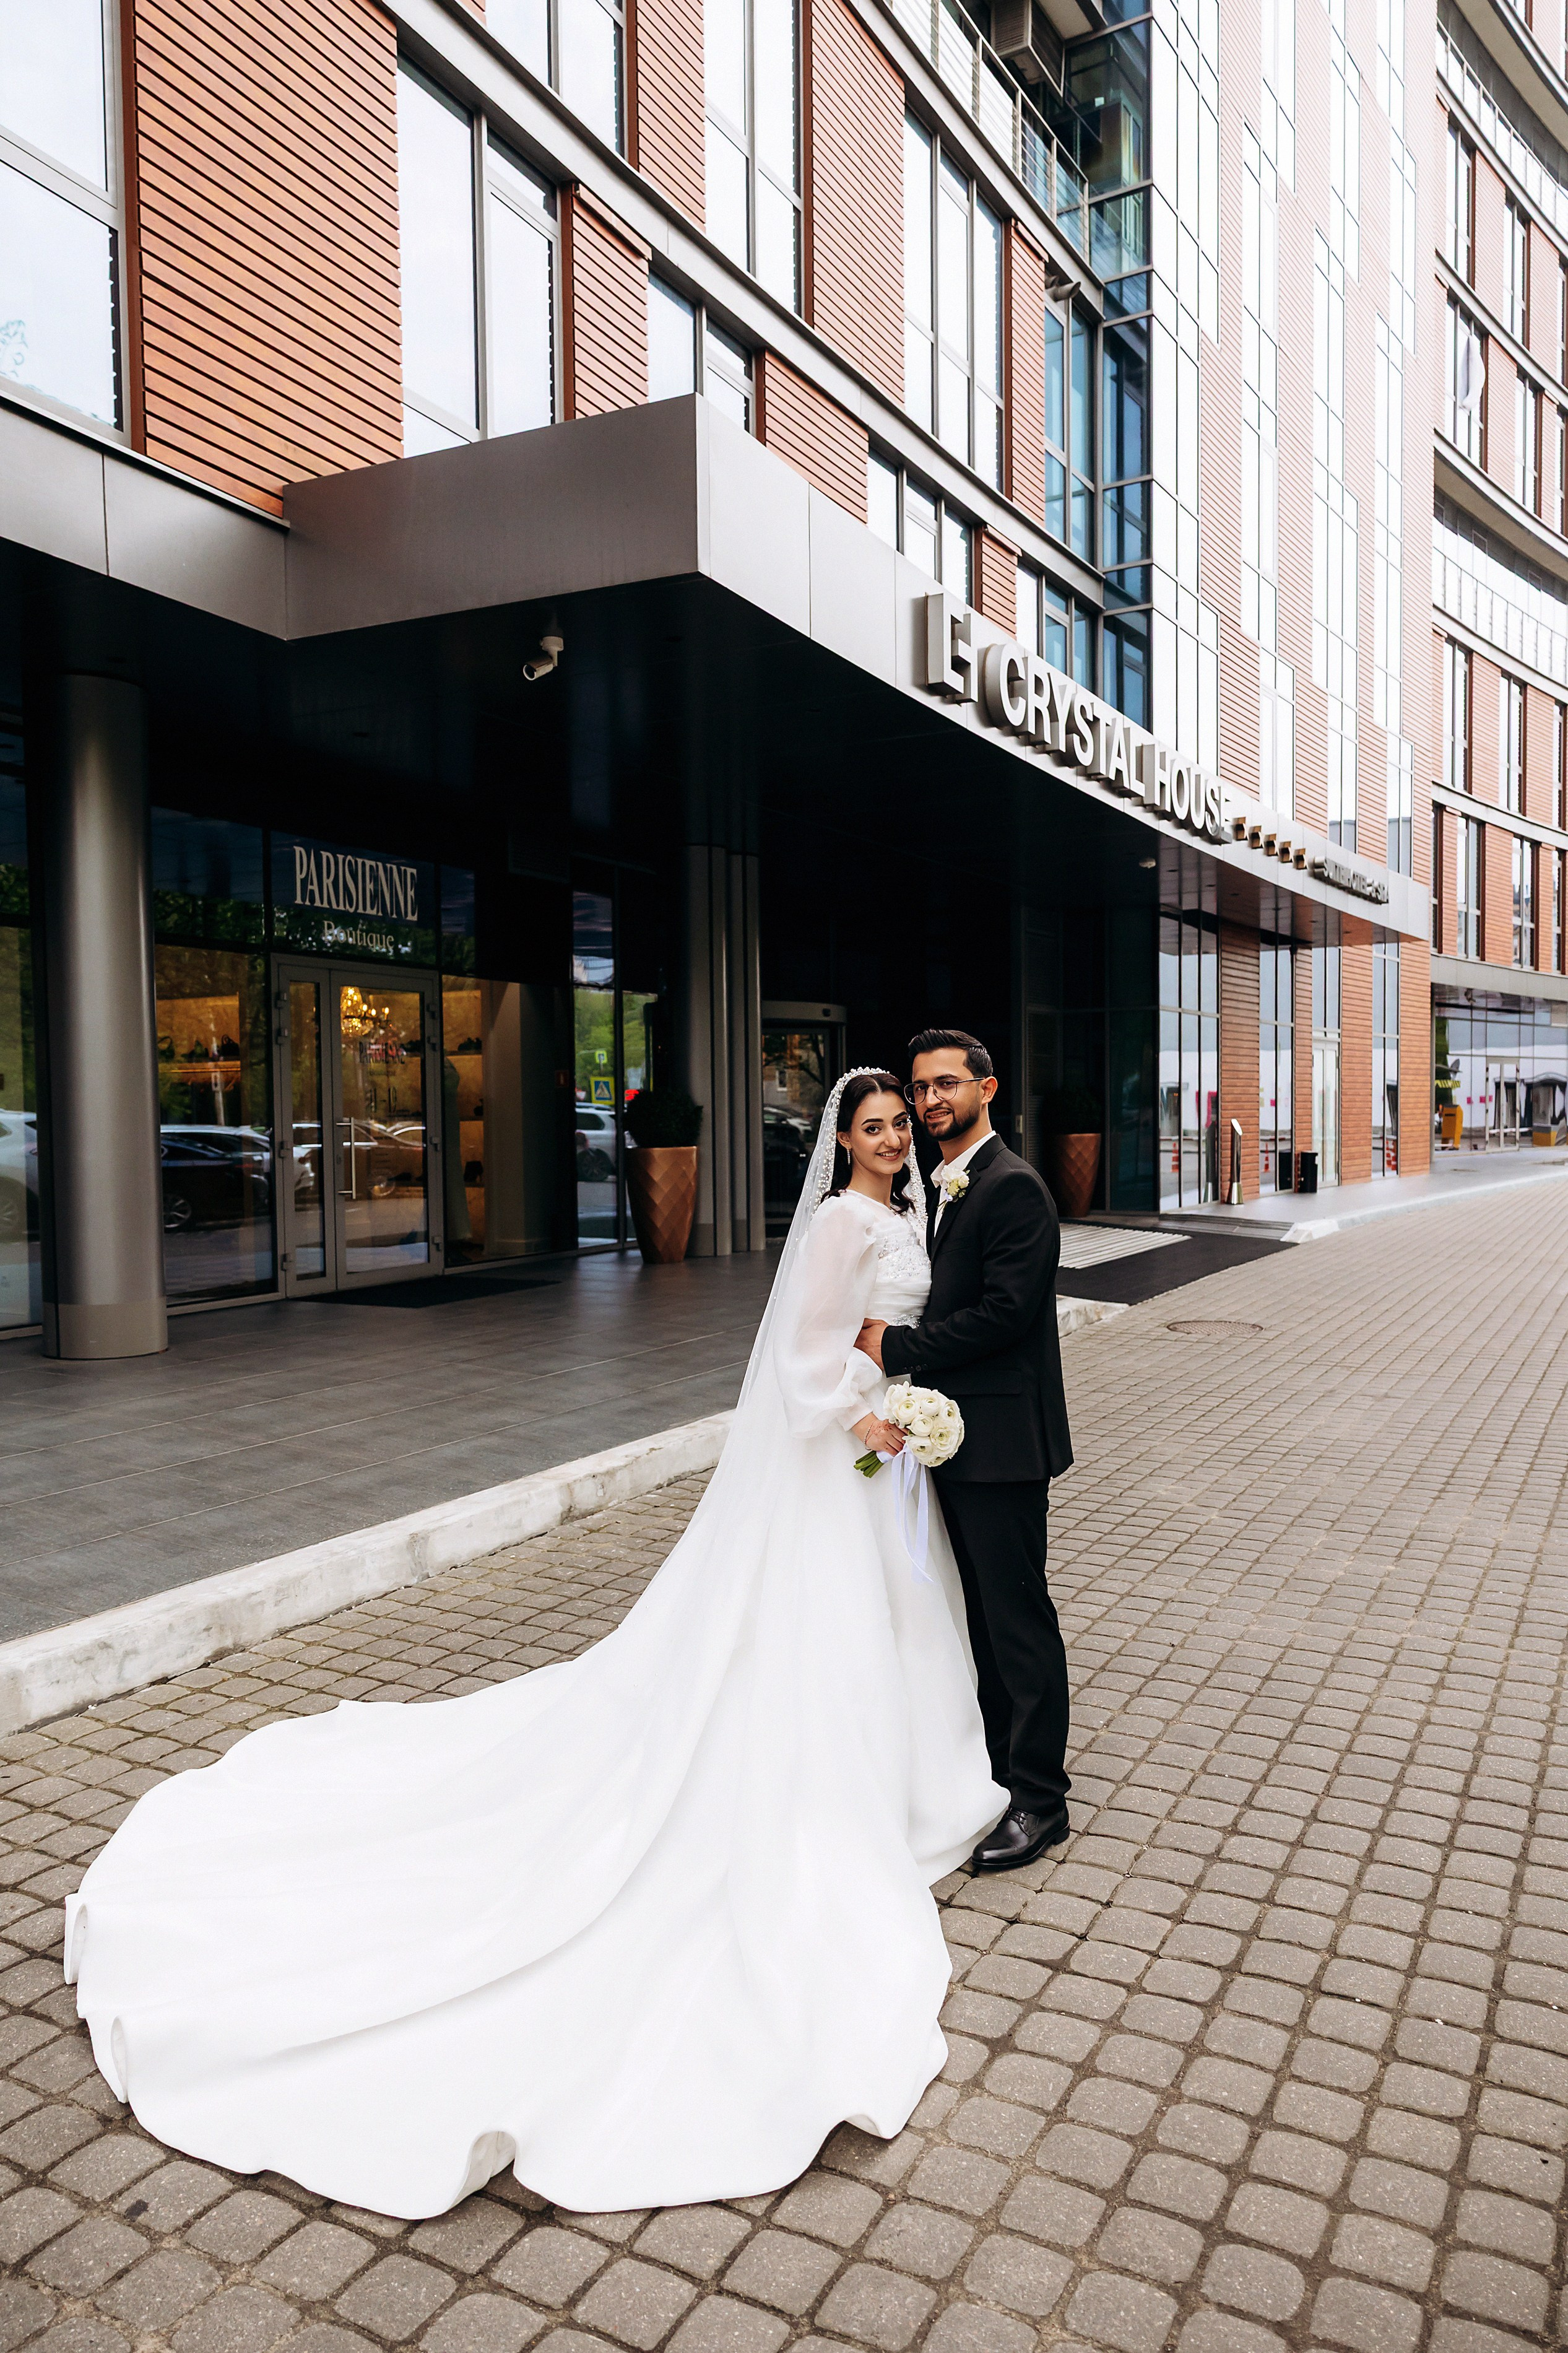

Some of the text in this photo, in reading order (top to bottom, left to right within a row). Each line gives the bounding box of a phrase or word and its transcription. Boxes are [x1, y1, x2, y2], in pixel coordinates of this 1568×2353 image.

[986, 643, 1145, 798] CRYSTAL
[1143, 744, 1232, 843] HOUSE
[293, 846, 418, 921] PARISIENNE
[324, 920, 394, 950] Boutique
